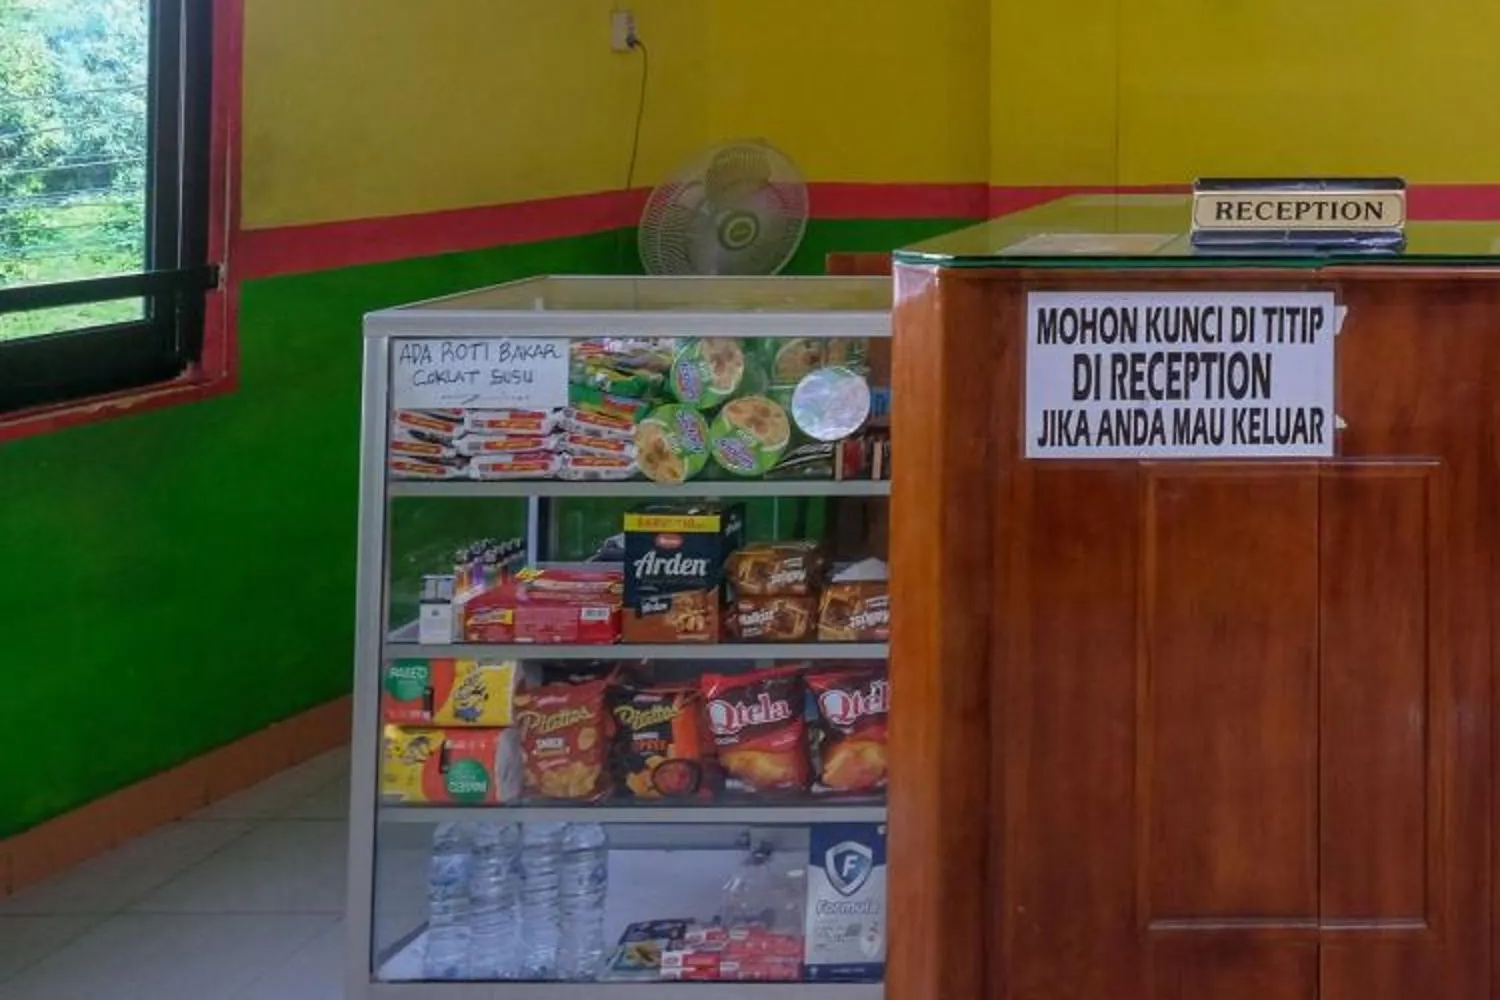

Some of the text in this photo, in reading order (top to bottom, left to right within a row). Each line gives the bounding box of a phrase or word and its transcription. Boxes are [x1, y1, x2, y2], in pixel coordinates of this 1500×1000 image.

[1215, 200, 1384, 221] RECEPTION
[1036, 305, 1325, 344] MOHON KUNCI DI TITIP
[400, 340, 562, 364] ADA ROTI BAKAR
[412, 368, 534, 386] COKLAT SUSU
[1072, 352, 1271, 400] DI RECEPTION
[1036, 407, 1325, 448] JIKA ANDA MAU KELUAR
[633, 551, 709, 577] Arden
[706, 693, 792, 735] Qtela
[820, 680, 889, 725] Qtel
[842, 855, 858, 877] F
